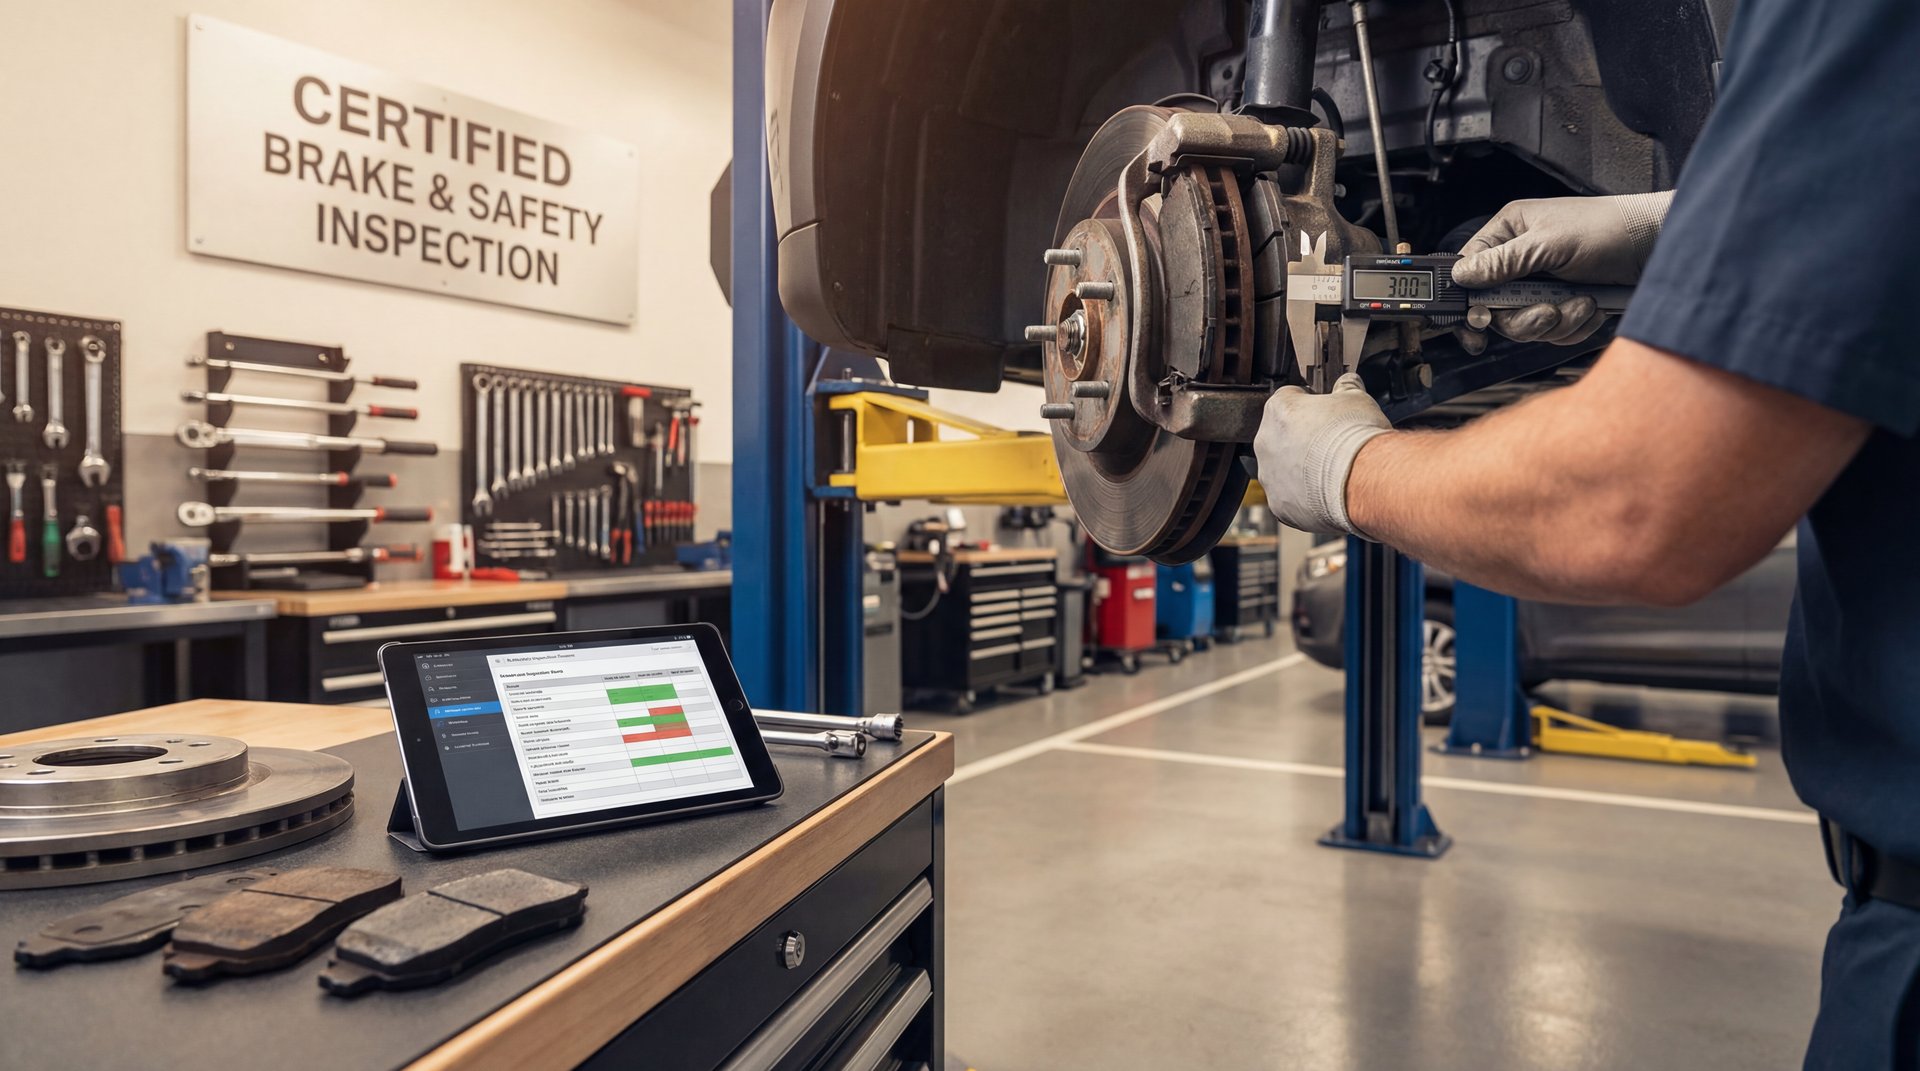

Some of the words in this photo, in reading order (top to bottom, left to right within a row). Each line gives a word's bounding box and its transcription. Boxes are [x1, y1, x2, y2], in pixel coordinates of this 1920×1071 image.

[293, 75, 572, 187] CERTIFIED
[264, 131, 415, 204] BRAKE
[429, 173, 454, 214] &
[468, 183, 603, 245] SAFETY
[317, 203, 559, 286] INSPECTION
